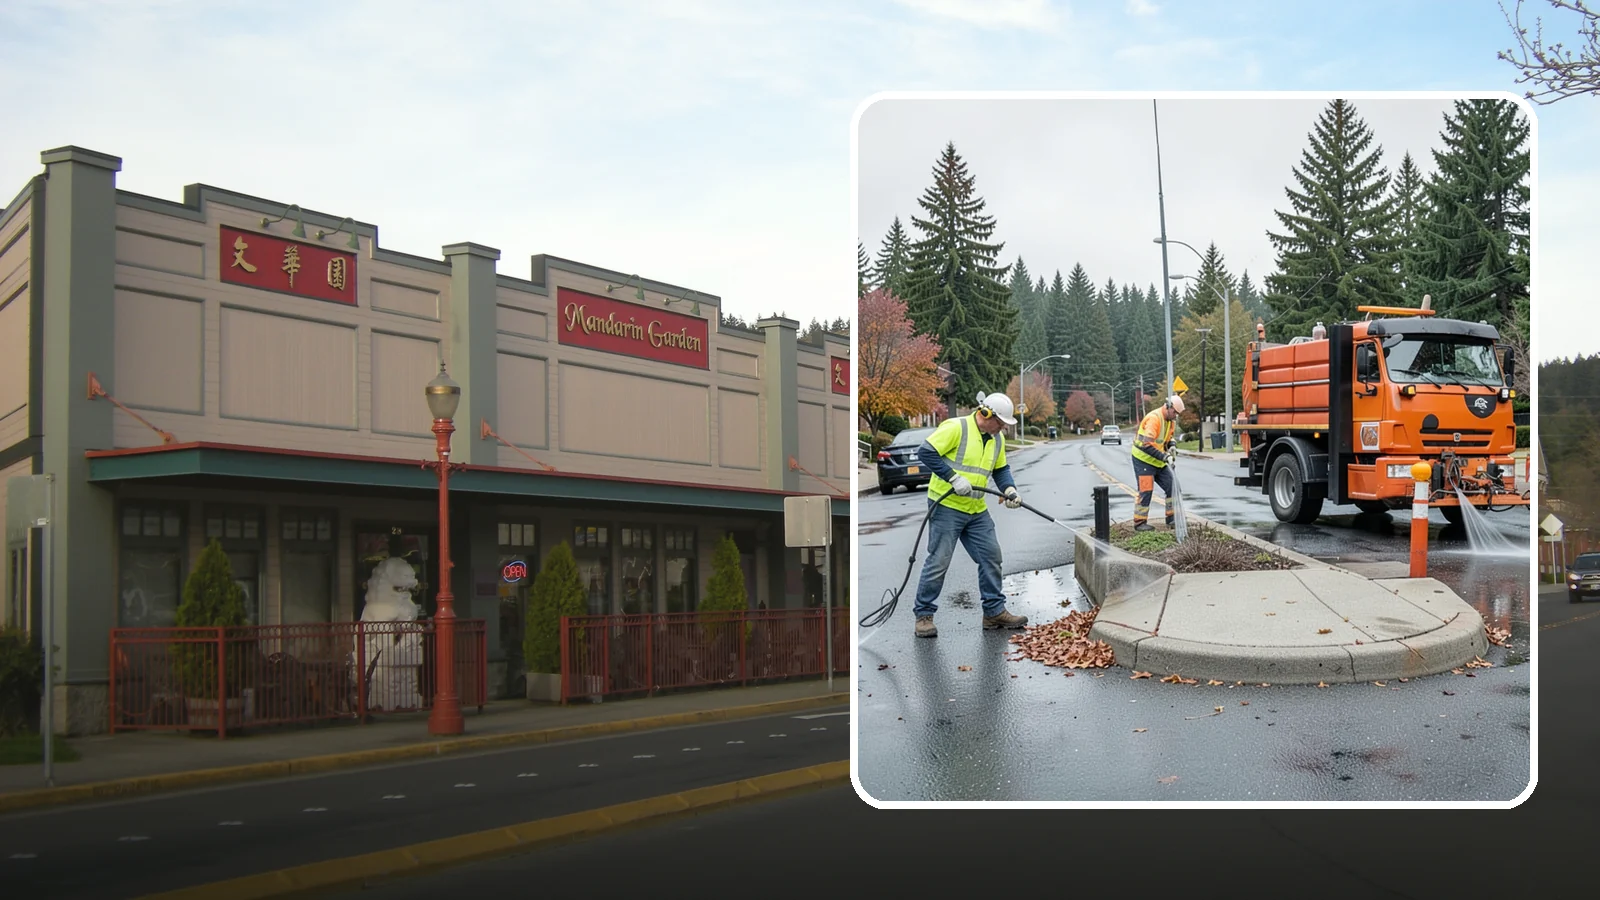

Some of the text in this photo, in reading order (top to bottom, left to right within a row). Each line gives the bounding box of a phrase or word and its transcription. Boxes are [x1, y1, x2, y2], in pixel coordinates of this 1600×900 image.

[231, 235, 346, 291] 文華園
[564, 302, 702, 352] Mandarin Garden
[503, 565, 527, 578] OPEN
